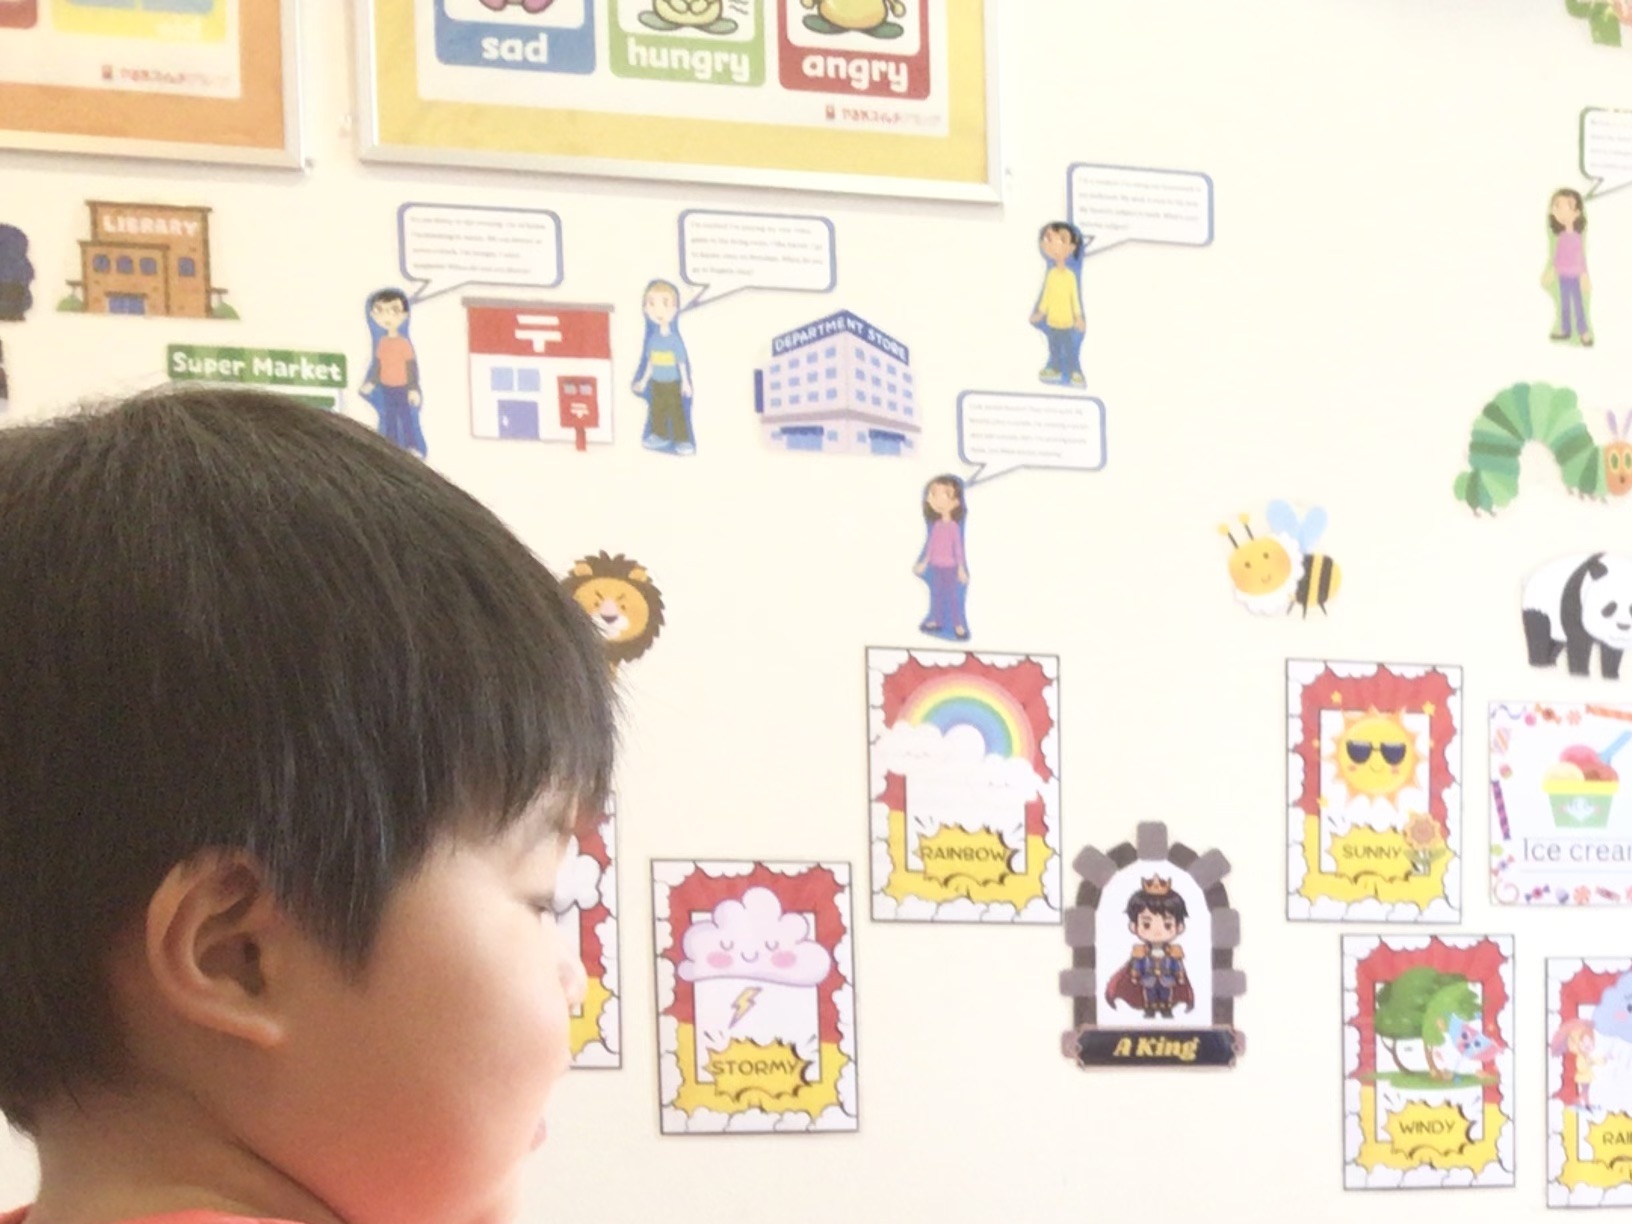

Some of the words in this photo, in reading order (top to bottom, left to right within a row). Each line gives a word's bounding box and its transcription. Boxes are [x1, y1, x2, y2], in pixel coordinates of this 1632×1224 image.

[481, 33, 549, 64] sad
[627, 37, 750, 83] hungry
[802, 52, 908, 94] angry
[102, 214, 200, 237] LIBRARY
[774, 315, 864, 353] DEPARTMENT
[867, 328, 908, 362] STORE
[172, 351, 245, 376] Super
[252, 356, 342, 382] Market
[921, 844, 1006, 864] RAINBOW
[1342, 844, 1402, 861] SUNNY
[1522, 838, 1562, 864] Ice
[1113, 1037, 1132, 1059] A
[1137, 1036, 1200, 1062] King
[712, 1058, 798, 1078] STORMY
[1398, 1118, 1457, 1136] WINDY
